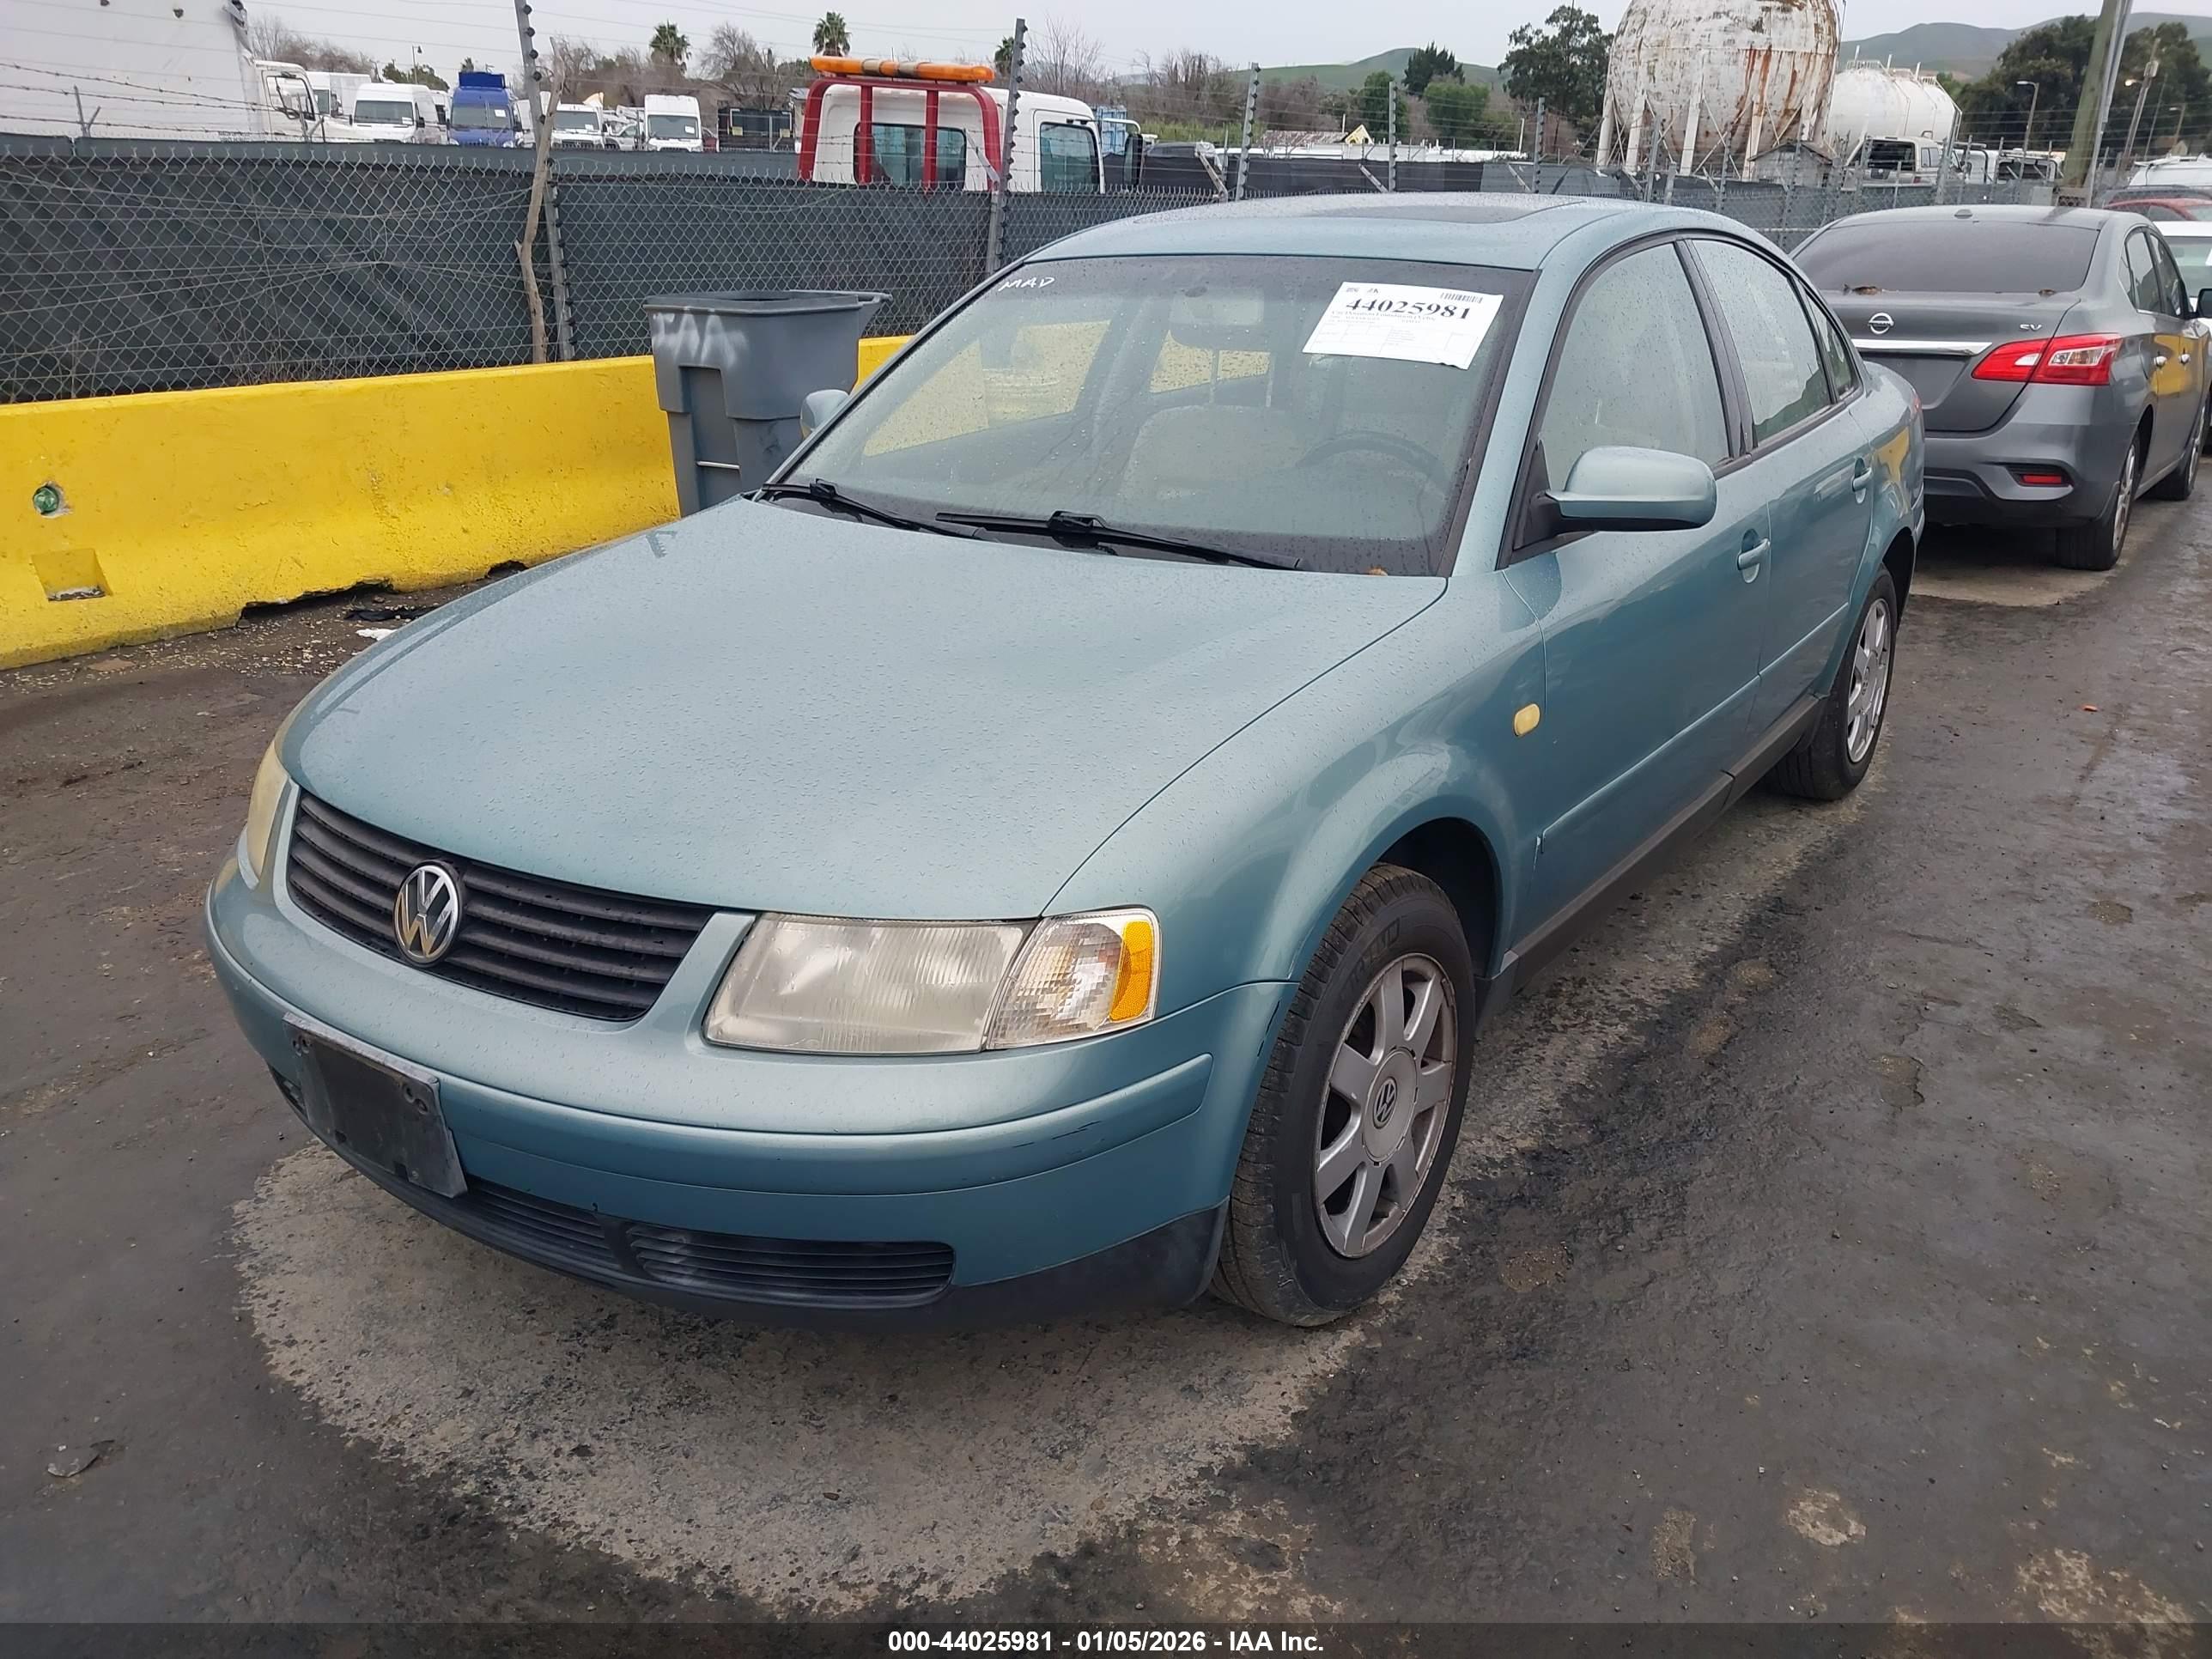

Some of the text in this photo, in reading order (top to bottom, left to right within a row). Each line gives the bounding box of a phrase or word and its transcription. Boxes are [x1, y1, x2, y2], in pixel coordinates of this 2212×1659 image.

[1346, 298, 1471, 320] 44025981
[394, 864, 459, 963] VW
[1373, 1078, 1397, 1128] VW
